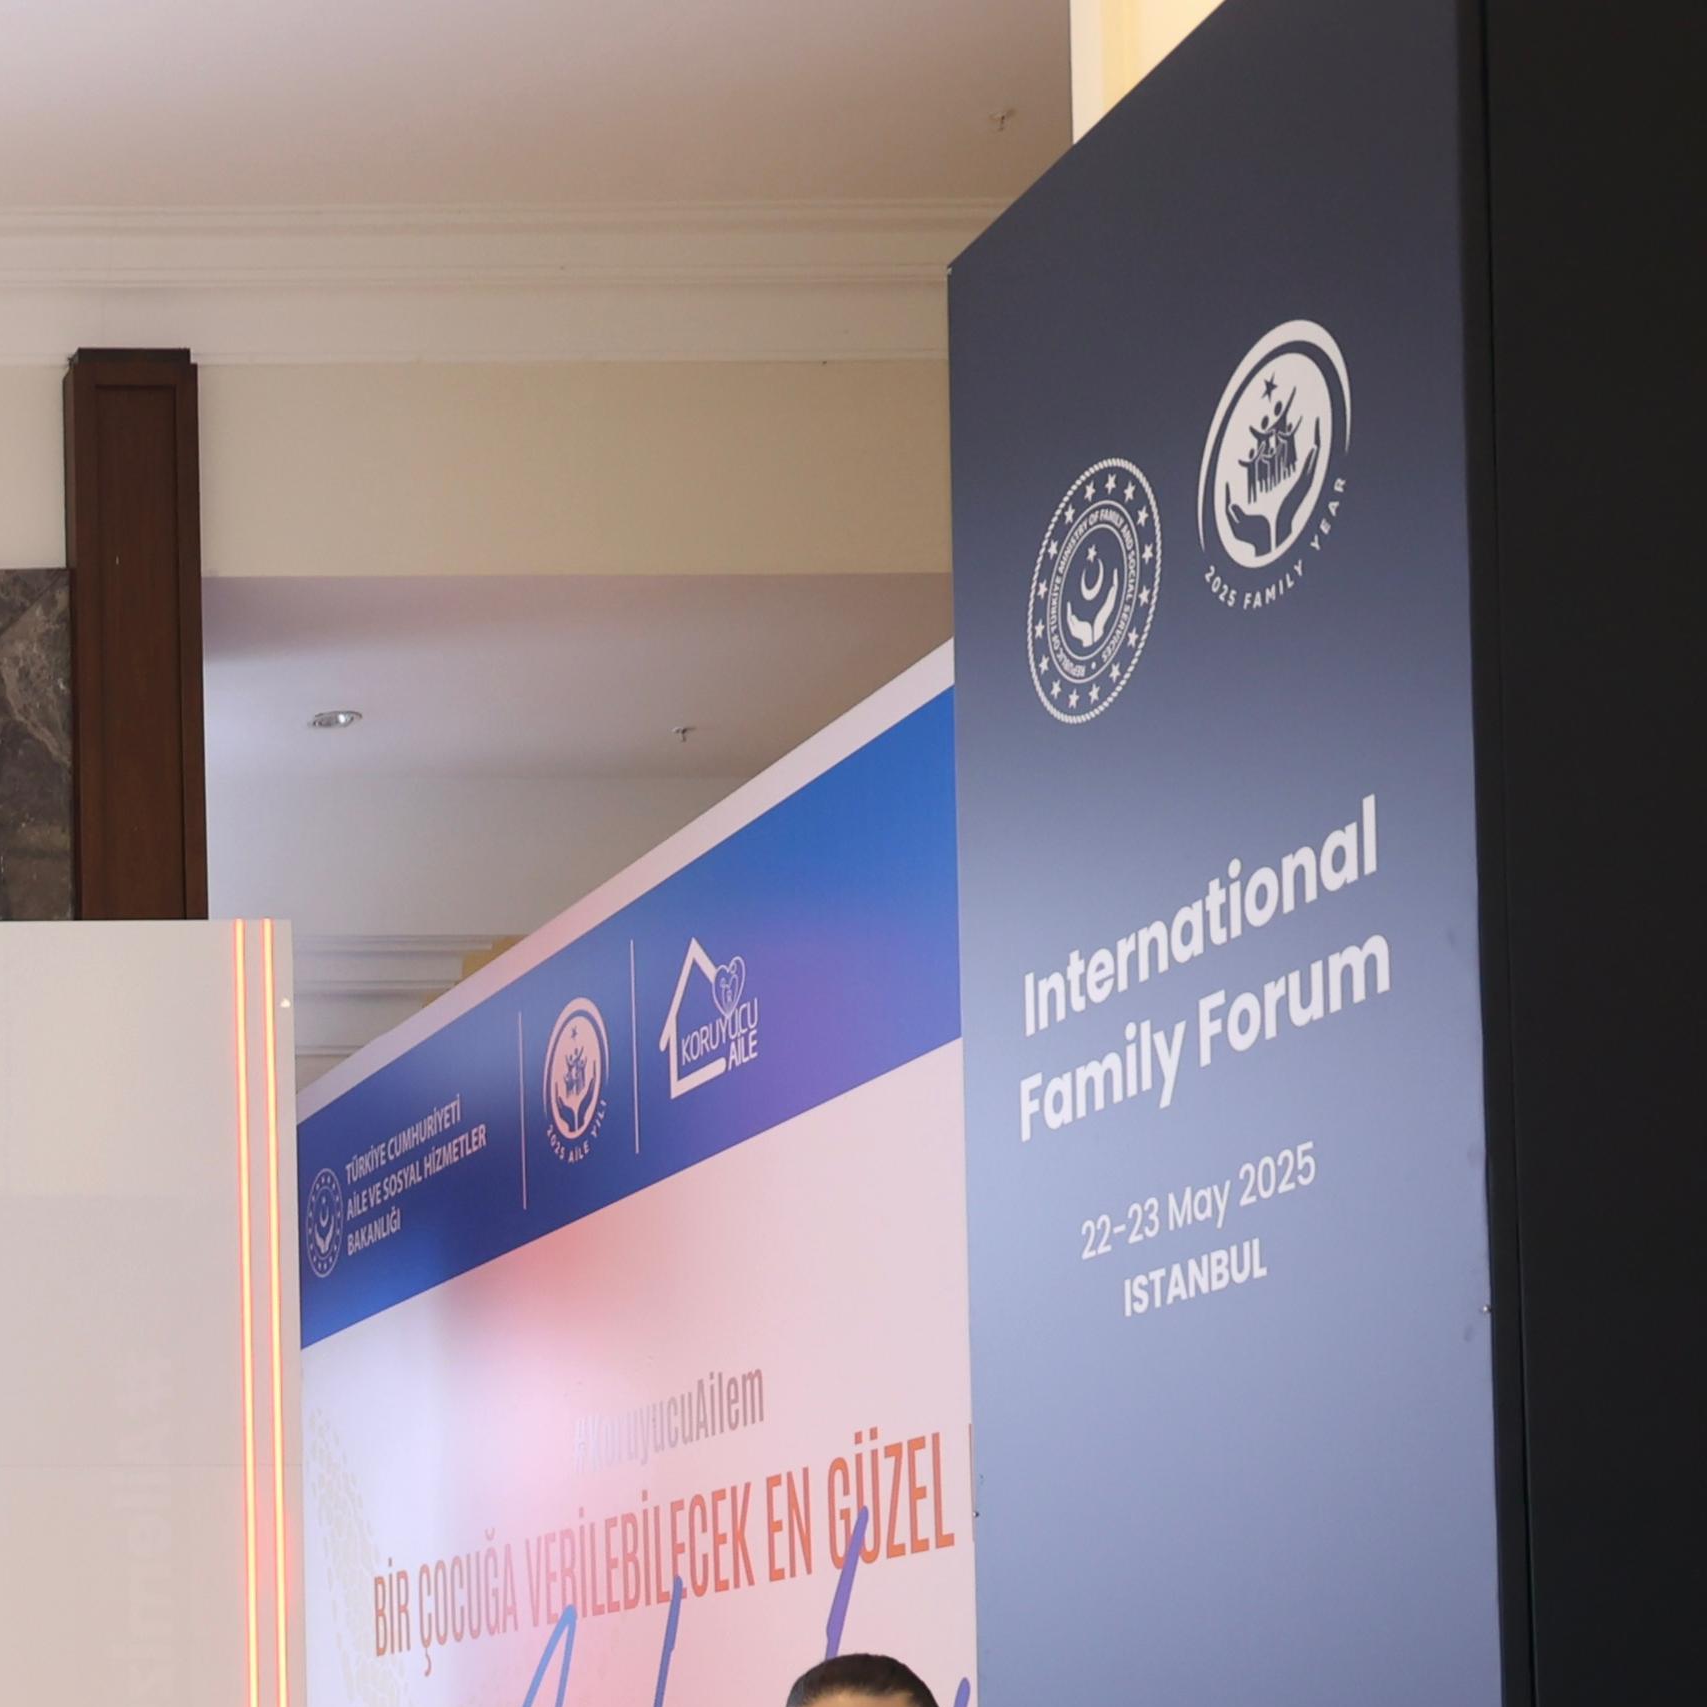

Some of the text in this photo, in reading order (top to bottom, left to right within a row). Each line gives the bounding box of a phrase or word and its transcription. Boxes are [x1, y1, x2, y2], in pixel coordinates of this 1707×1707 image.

[1204, 478, 1347, 610] 2025 FAMILY YEAR
[1024, 793, 1378, 1038] International
[681, 997, 759, 1066] KORUYUCU
[728, 1030, 759, 1071] AİLE
[1020, 934, 1391, 1142] Family Forum
[345, 1092, 462, 1185] TÜRKİYE CUMHURİYETİ
[347, 1123, 487, 1221] AİLE VE SOSYAL HİZMETLER
[347, 1206, 401, 1256] BAKANLIĞI
[1081, 1140, 1317, 1260] 22-23 May 2025
[1124, 1237, 1268, 1317] ISTANBUL
[374, 1557, 411, 1657] BİR
[418, 1527, 519, 1677] ÇOCUĞA
[525, 1481, 755, 1628] VERİLEBİLECEK
[766, 1467, 813, 1582] EN
[827, 1426, 955, 1570] GÜZEL
